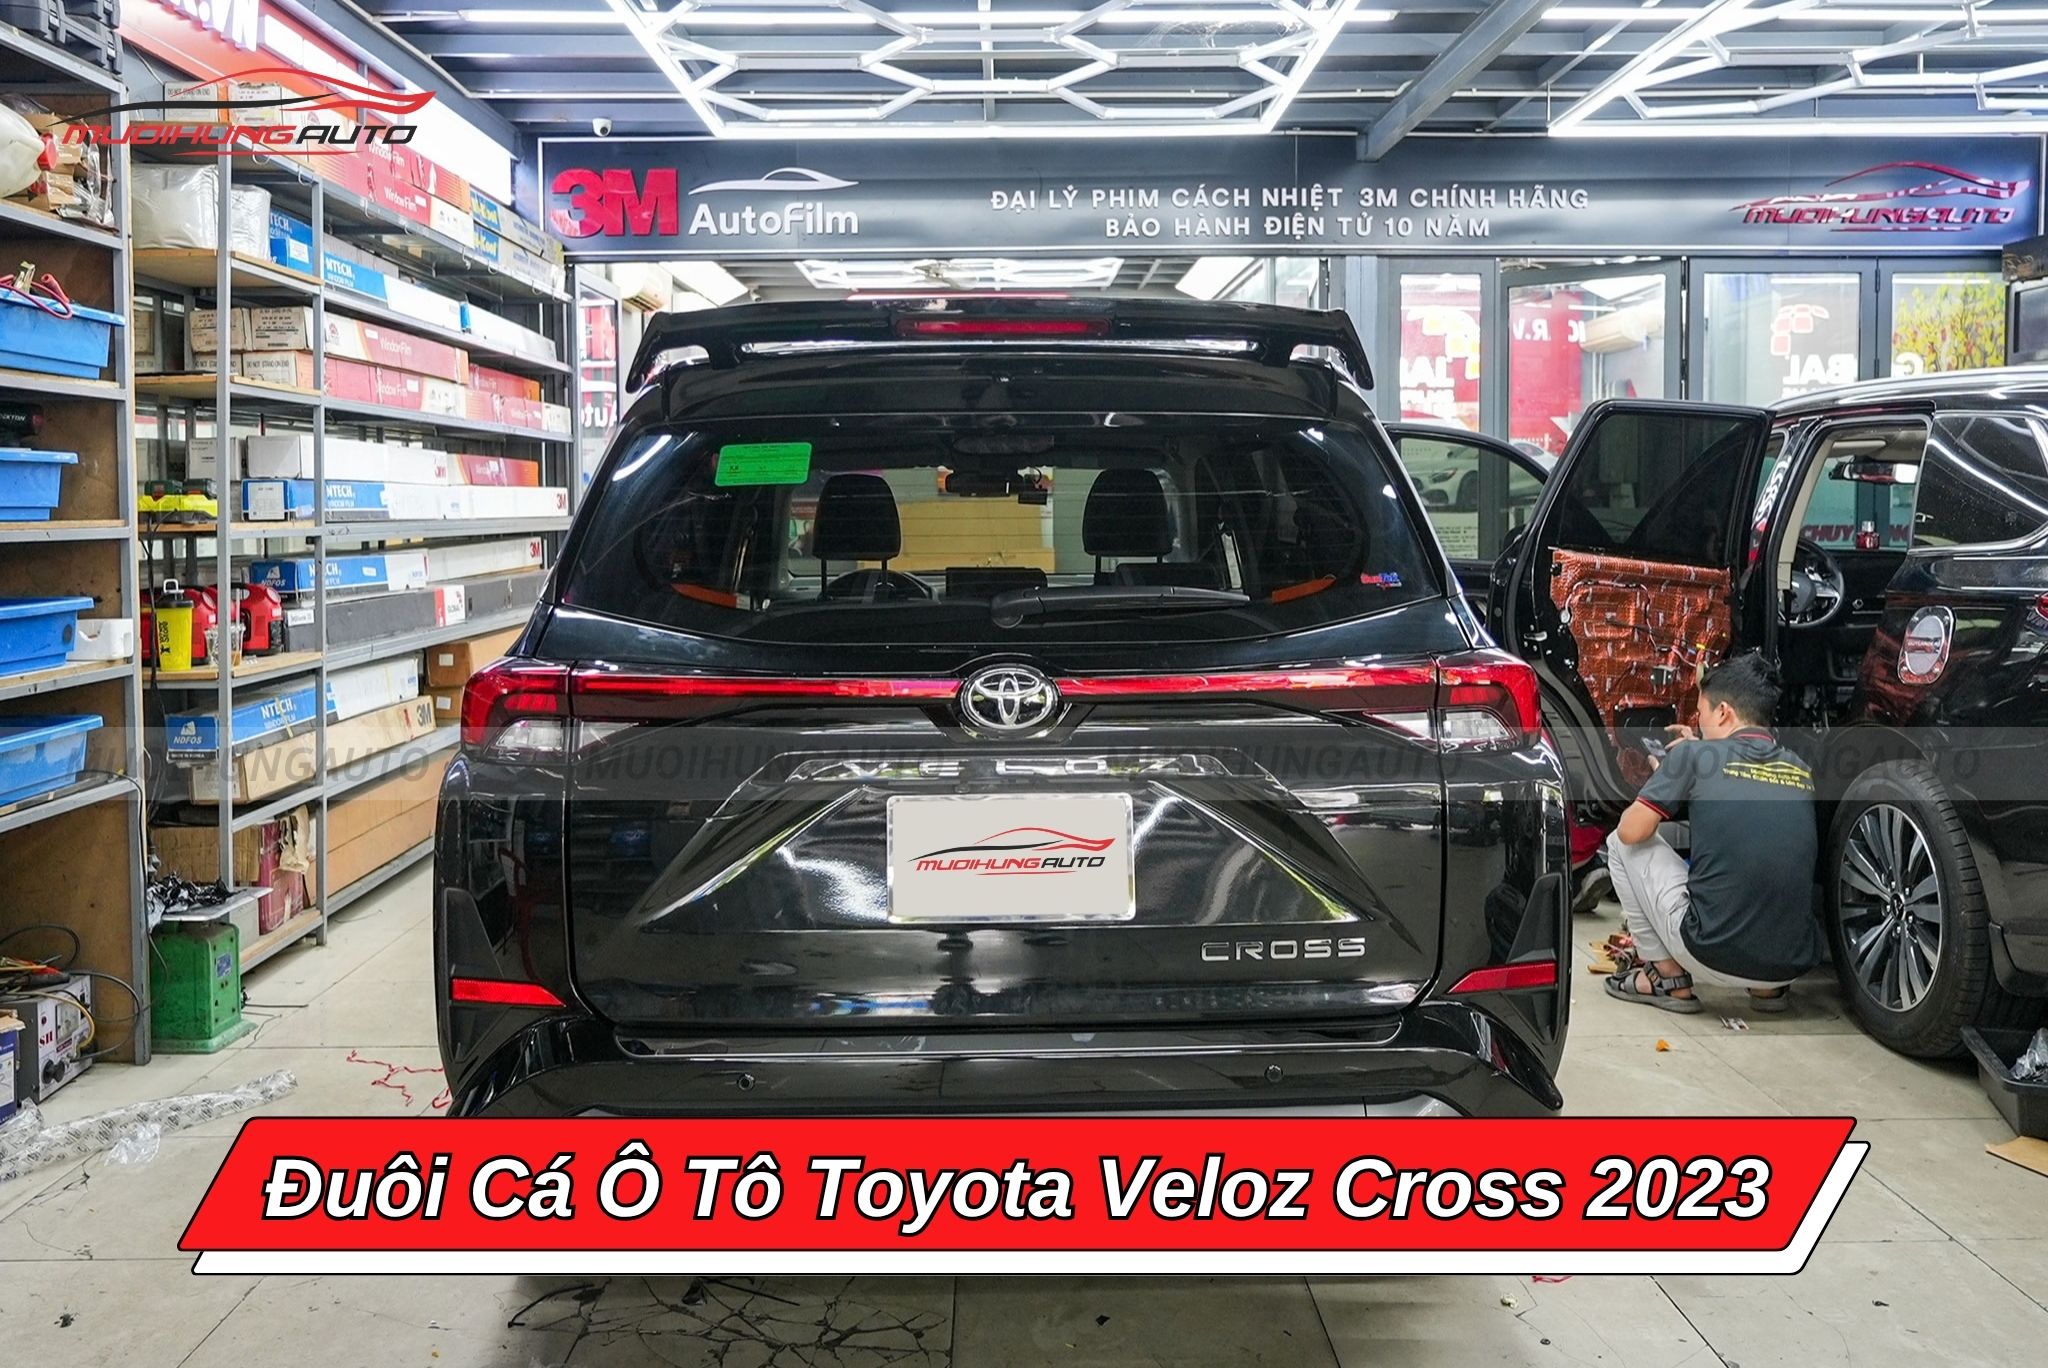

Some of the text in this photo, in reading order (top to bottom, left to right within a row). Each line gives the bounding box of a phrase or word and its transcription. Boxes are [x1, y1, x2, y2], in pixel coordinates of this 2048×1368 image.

[551, 168, 679, 236] 3M
[688, 203, 859, 236] AutoFilm
[990, 190, 1036, 214] ĐẠI
[1091, 188, 1160, 209] PHIM
[1171, 183, 1250, 209] CÁCH
[1262, 183, 1343, 212] NHIỆT
[1359, 187, 1398, 208] 3M
[1409, 183, 1497, 209] CHÍNH
[1508, 185, 1589, 209] HÃNG
[270, 214, 290, 232] TECH
[1743, 206, 2015, 224] MUOIHUNGAUTO
[1105, 211, 1491, 241] BẢO HÀNH ĐIỆN TỬ 10 NĂM
[325, 485, 353, 498] NTECH
[529, 541, 541, 558] 3M
[308, 561, 339, 577] NCH
[416, 702, 433, 727] 3M
[1200, 937, 1367, 961] CROSS
